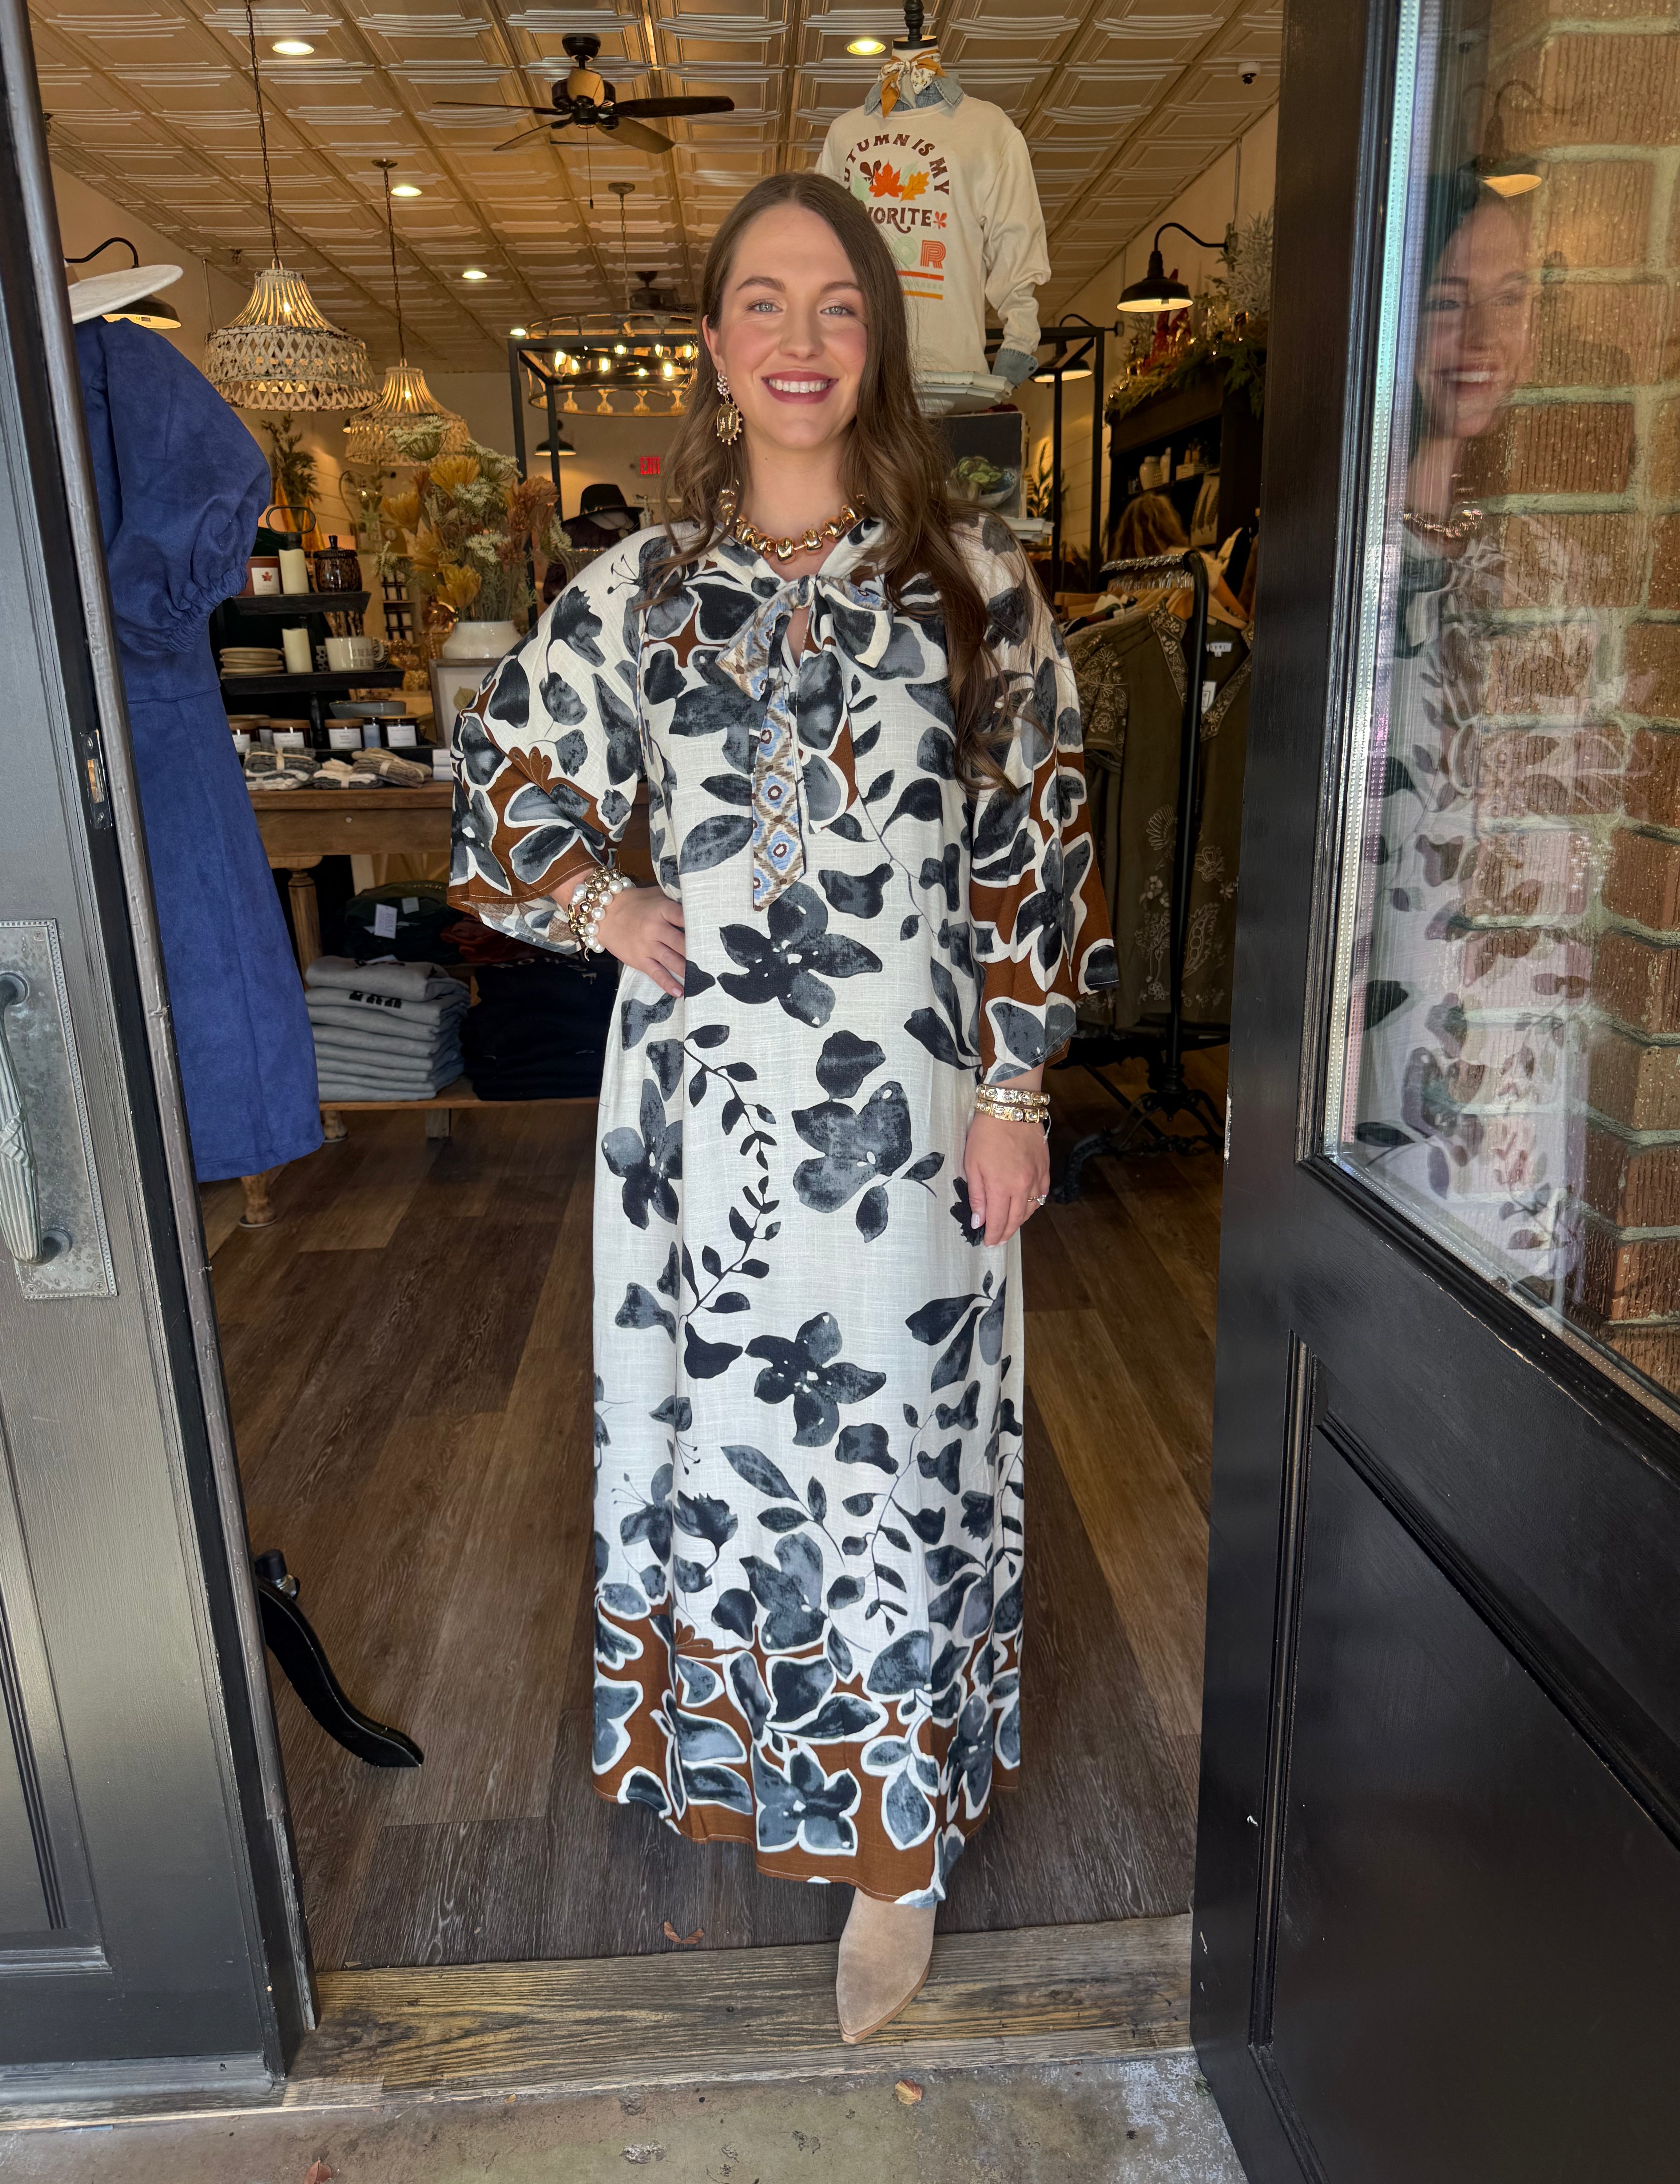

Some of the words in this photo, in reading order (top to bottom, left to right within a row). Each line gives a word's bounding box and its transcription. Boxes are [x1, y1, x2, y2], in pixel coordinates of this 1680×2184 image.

[844, 133, 910, 191] UTUMN
[911, 138, 935, 156] IS
[929, 156, 949, 195] MY
[640, 456, 660, 475] EXIT
